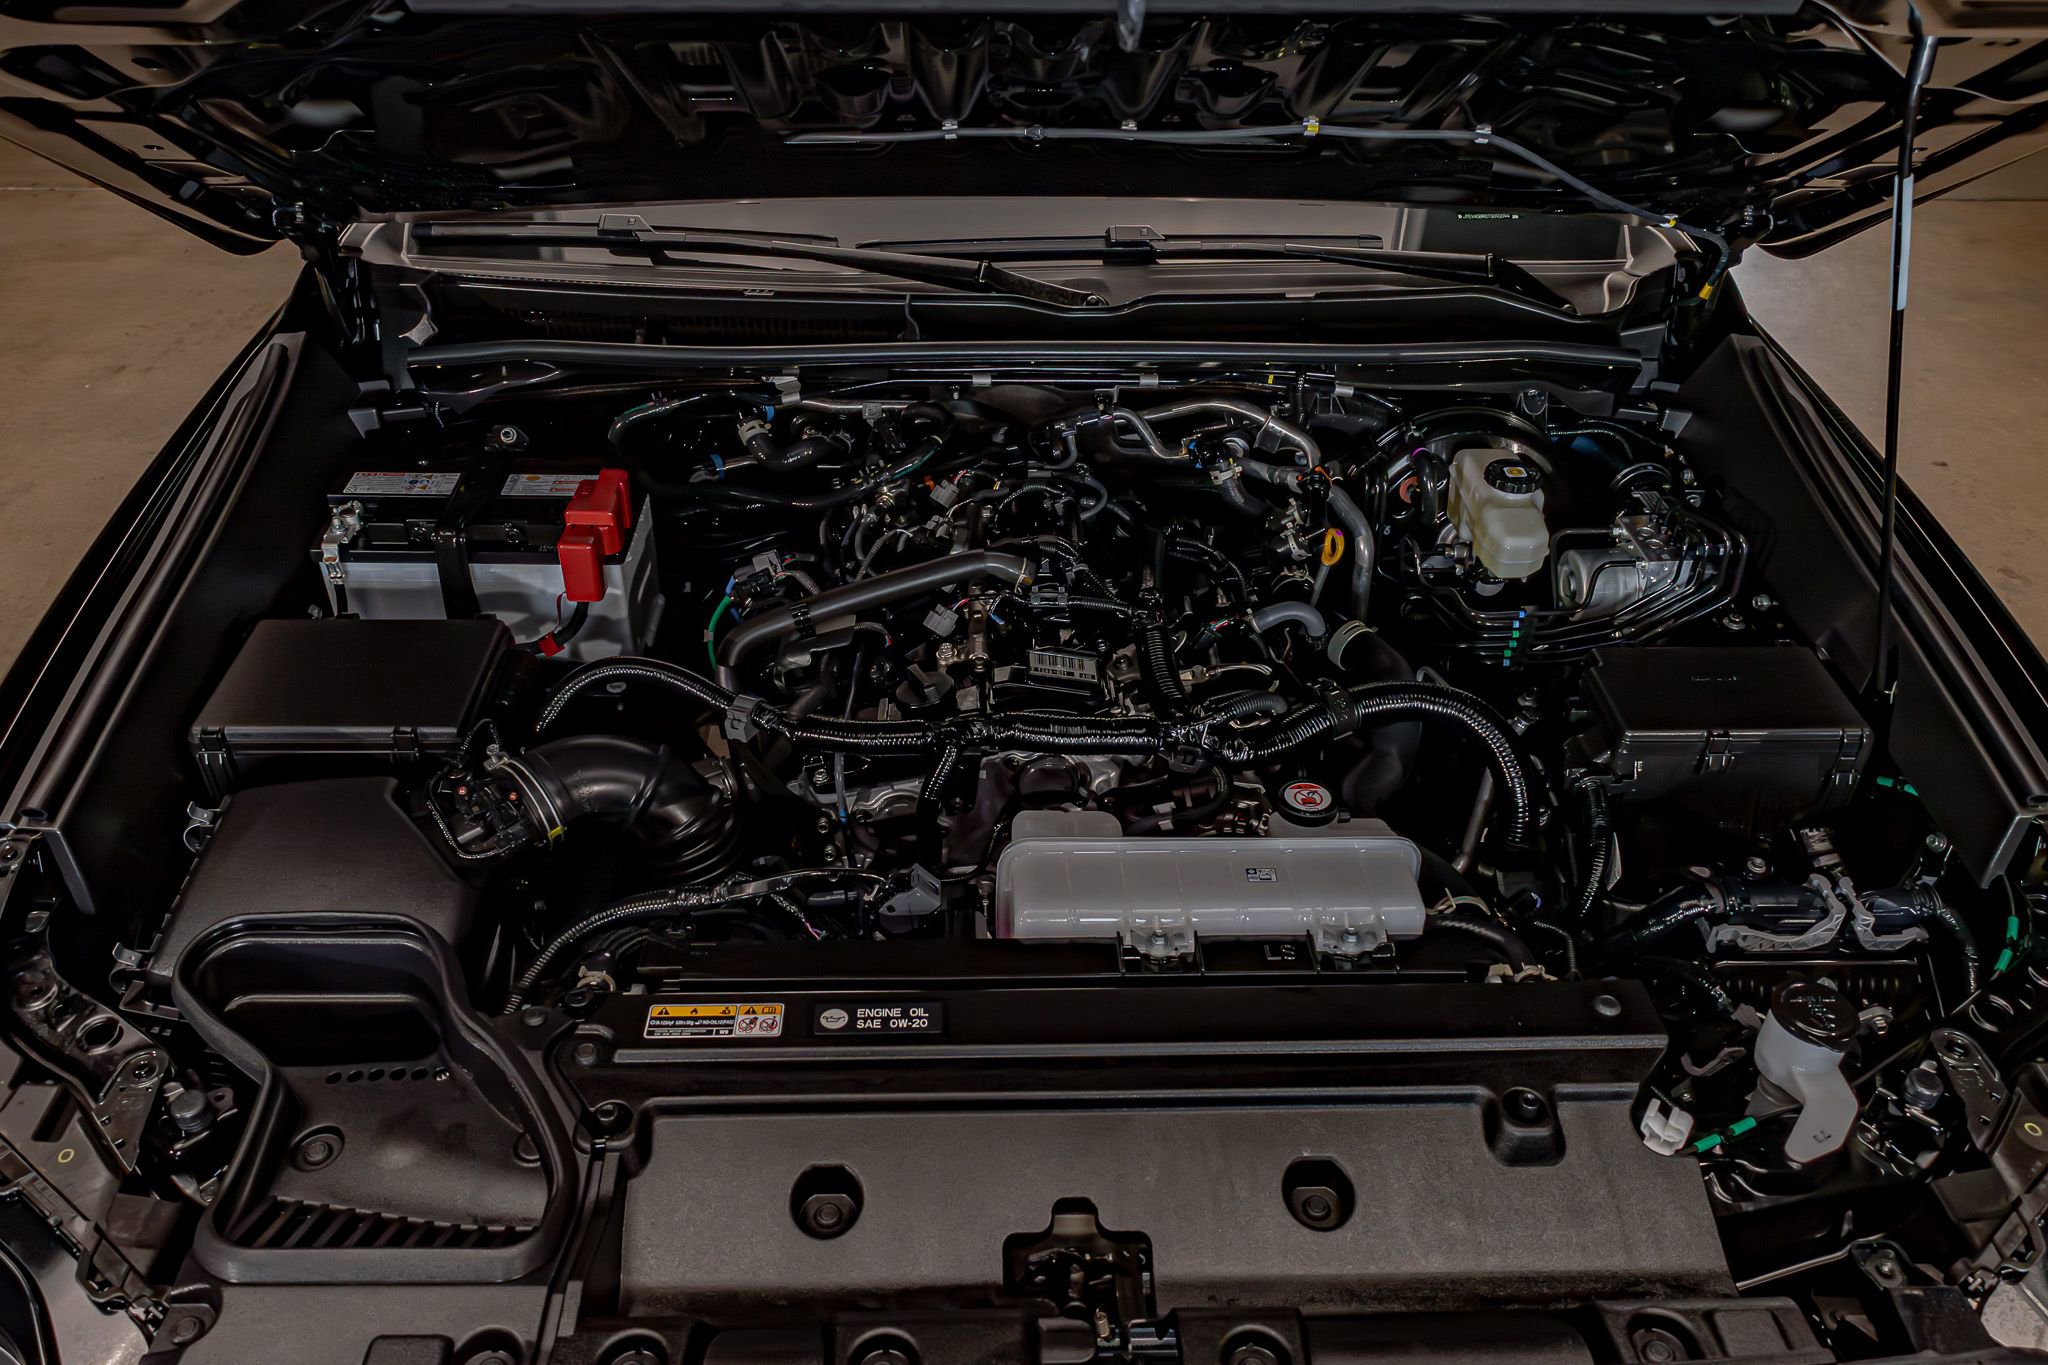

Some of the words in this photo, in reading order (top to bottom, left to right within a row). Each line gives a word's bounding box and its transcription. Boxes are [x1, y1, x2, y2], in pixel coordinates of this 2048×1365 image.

[857, 1008, 902, 1018] ENGINE
[909, 1007, 929, 1017] OIL
[856, 1018, 882, 1029] SAE
[889, 1017, 928, 1028] 0W-20
